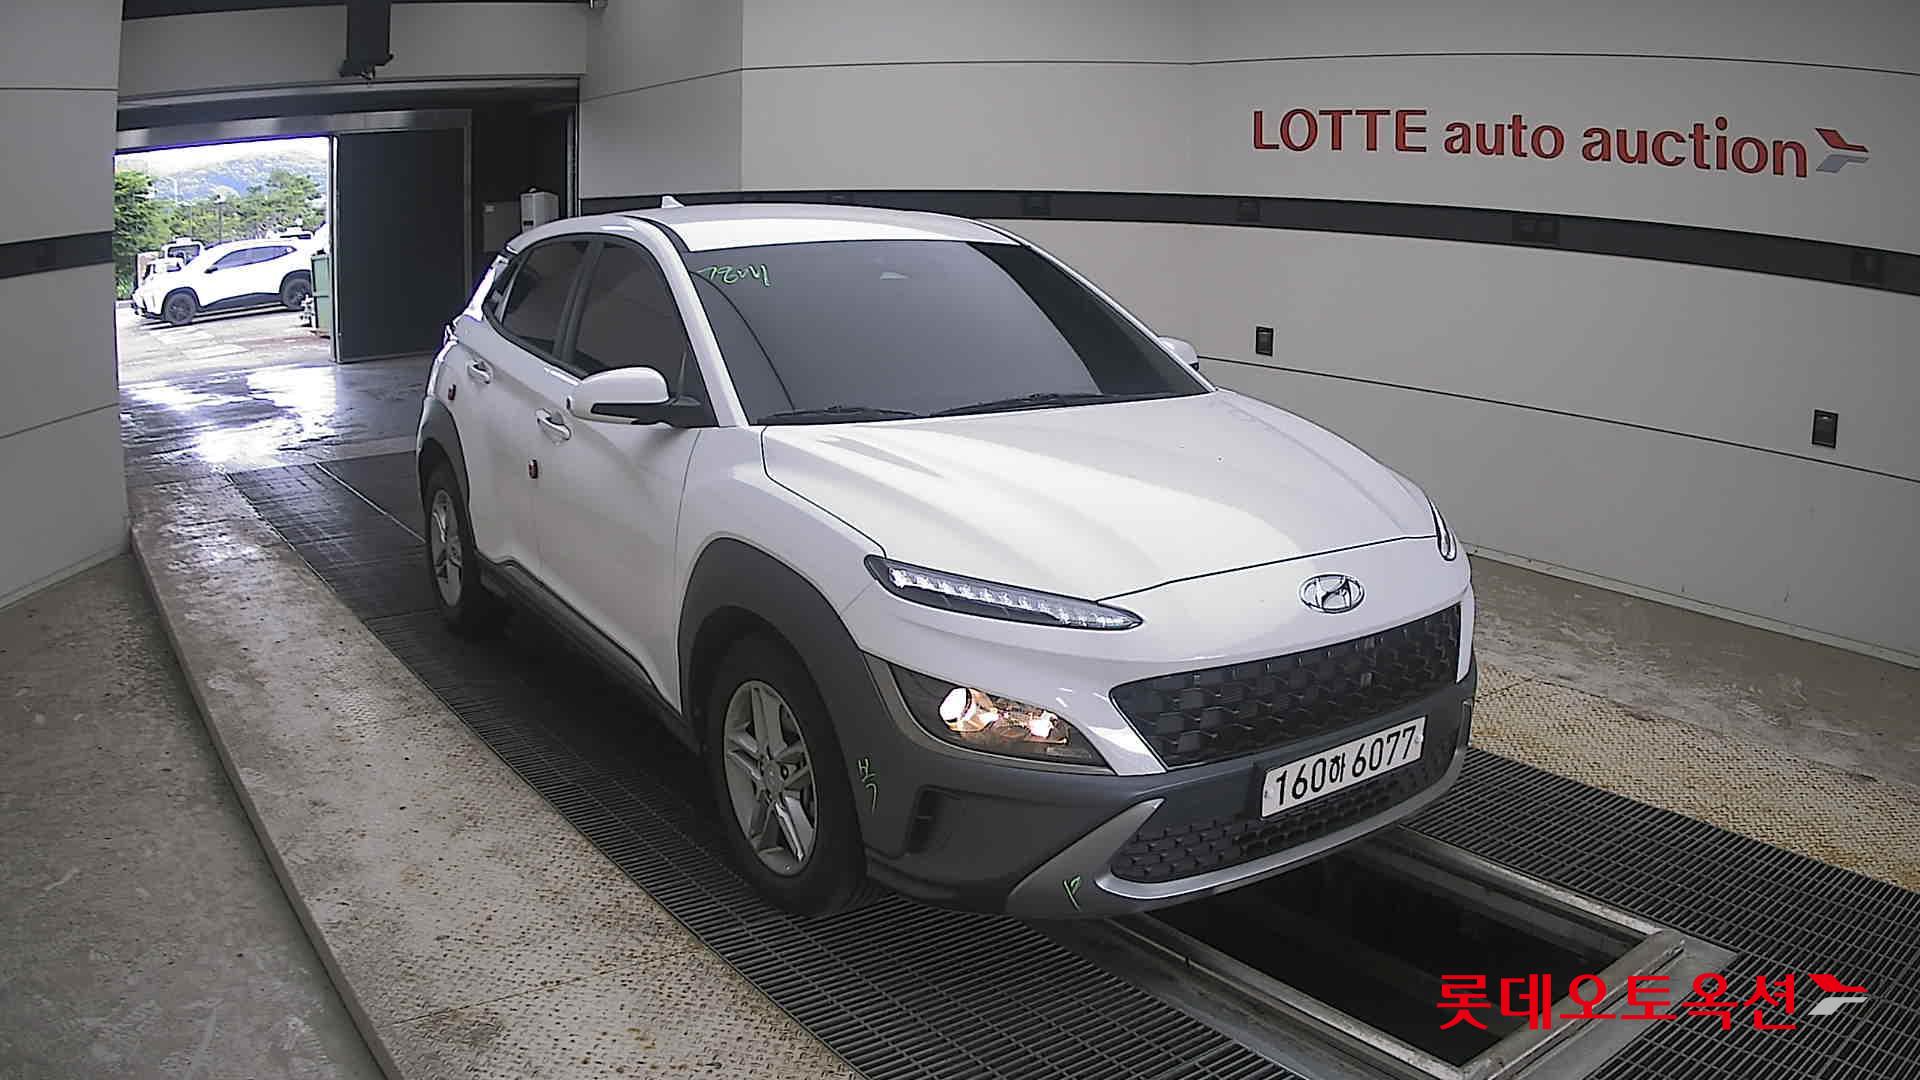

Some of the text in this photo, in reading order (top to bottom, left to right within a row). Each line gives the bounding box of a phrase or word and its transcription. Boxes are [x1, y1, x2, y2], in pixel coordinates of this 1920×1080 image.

[1253, 109, 1808, 179] LOTTE auto auction
[1276, 725, 1417, 806] 160하 6077
